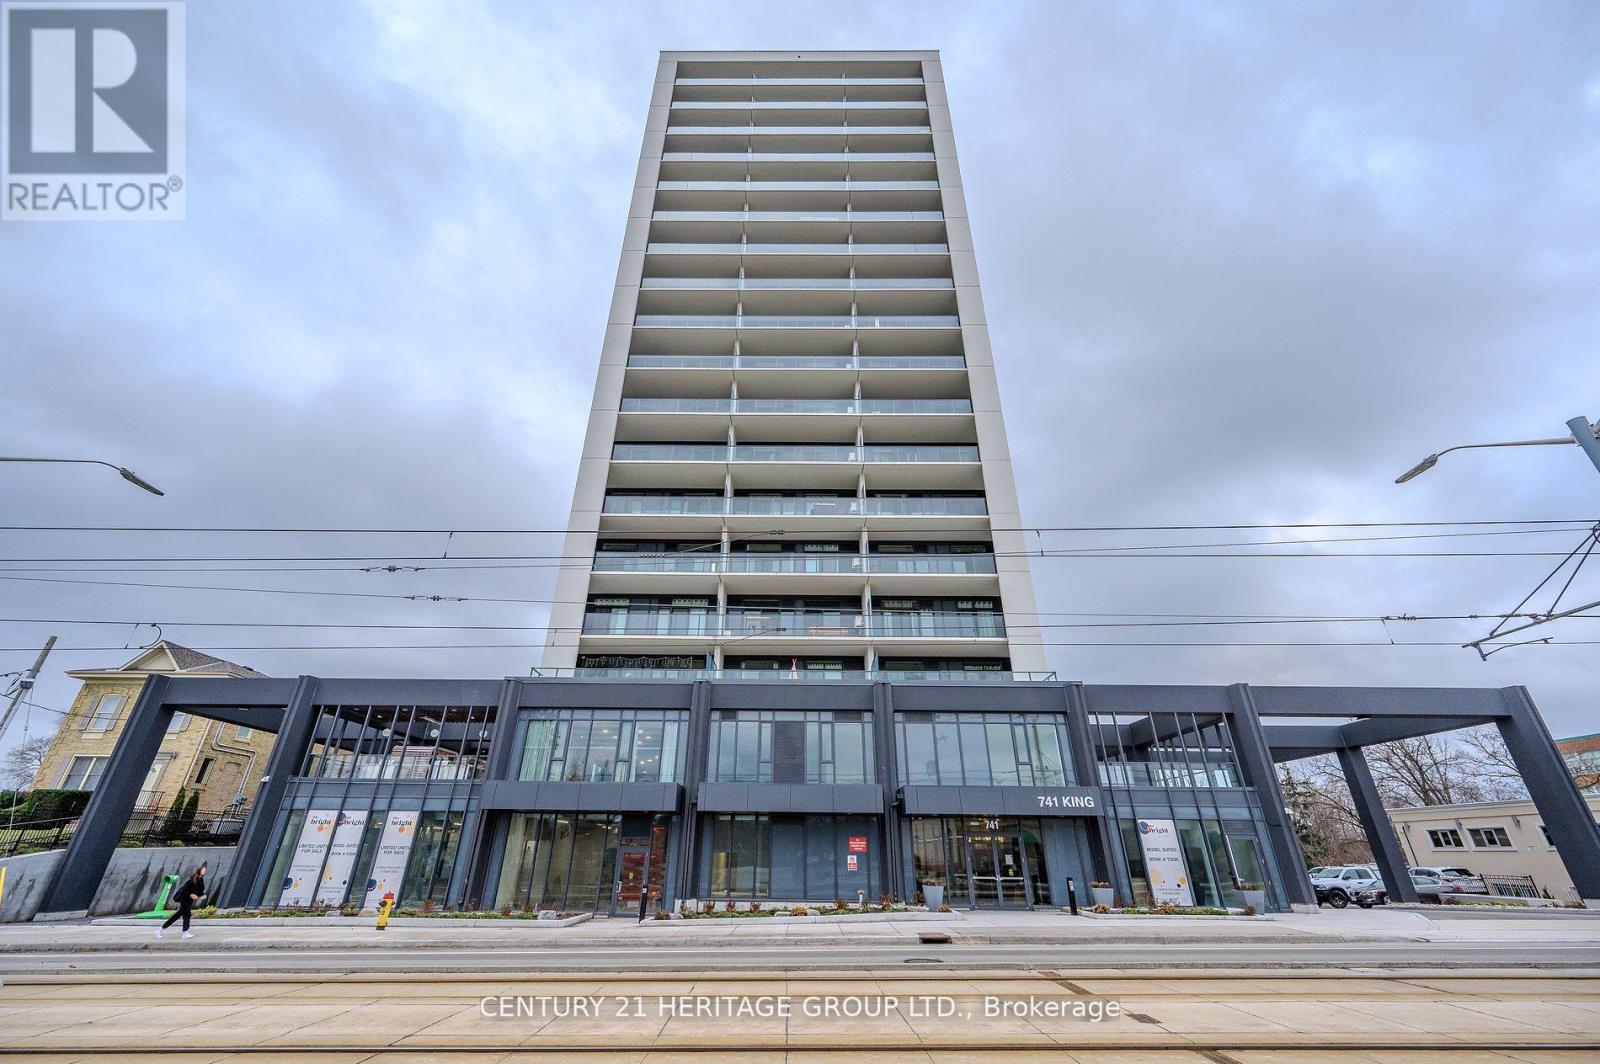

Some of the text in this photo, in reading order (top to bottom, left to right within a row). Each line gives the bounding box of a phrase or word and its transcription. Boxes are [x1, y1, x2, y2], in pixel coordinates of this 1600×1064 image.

[1037, 796, 1095, 808] 741 KING
[984, 819, 999, 830] 741
